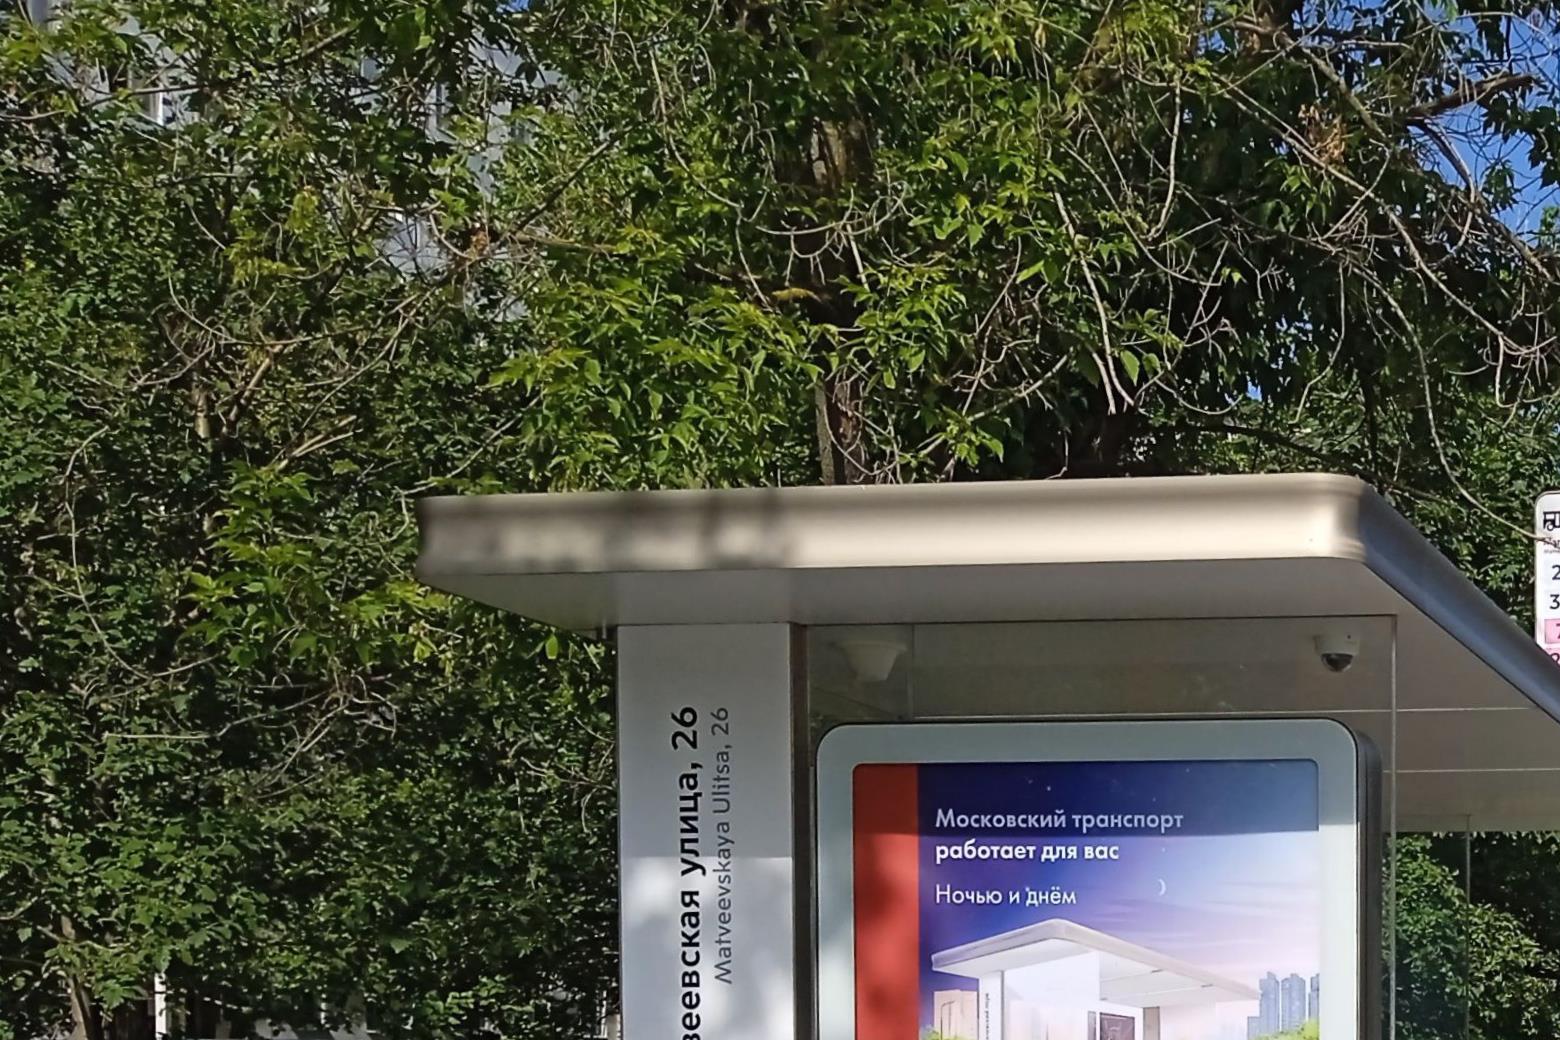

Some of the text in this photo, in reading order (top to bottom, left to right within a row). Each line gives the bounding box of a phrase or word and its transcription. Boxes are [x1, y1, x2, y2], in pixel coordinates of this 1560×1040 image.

[671, 706, 699, 751] 26
[674, 760, 706, 878] улица,
[935, 808, 1184, 834] Московский транспорт
[711, 706, 734, 985] Matveevskaya Ulitsa, 26
[935, 838, 1120, 864] работает для вас
[935, 884, 1077, 907] Ночью и днём
